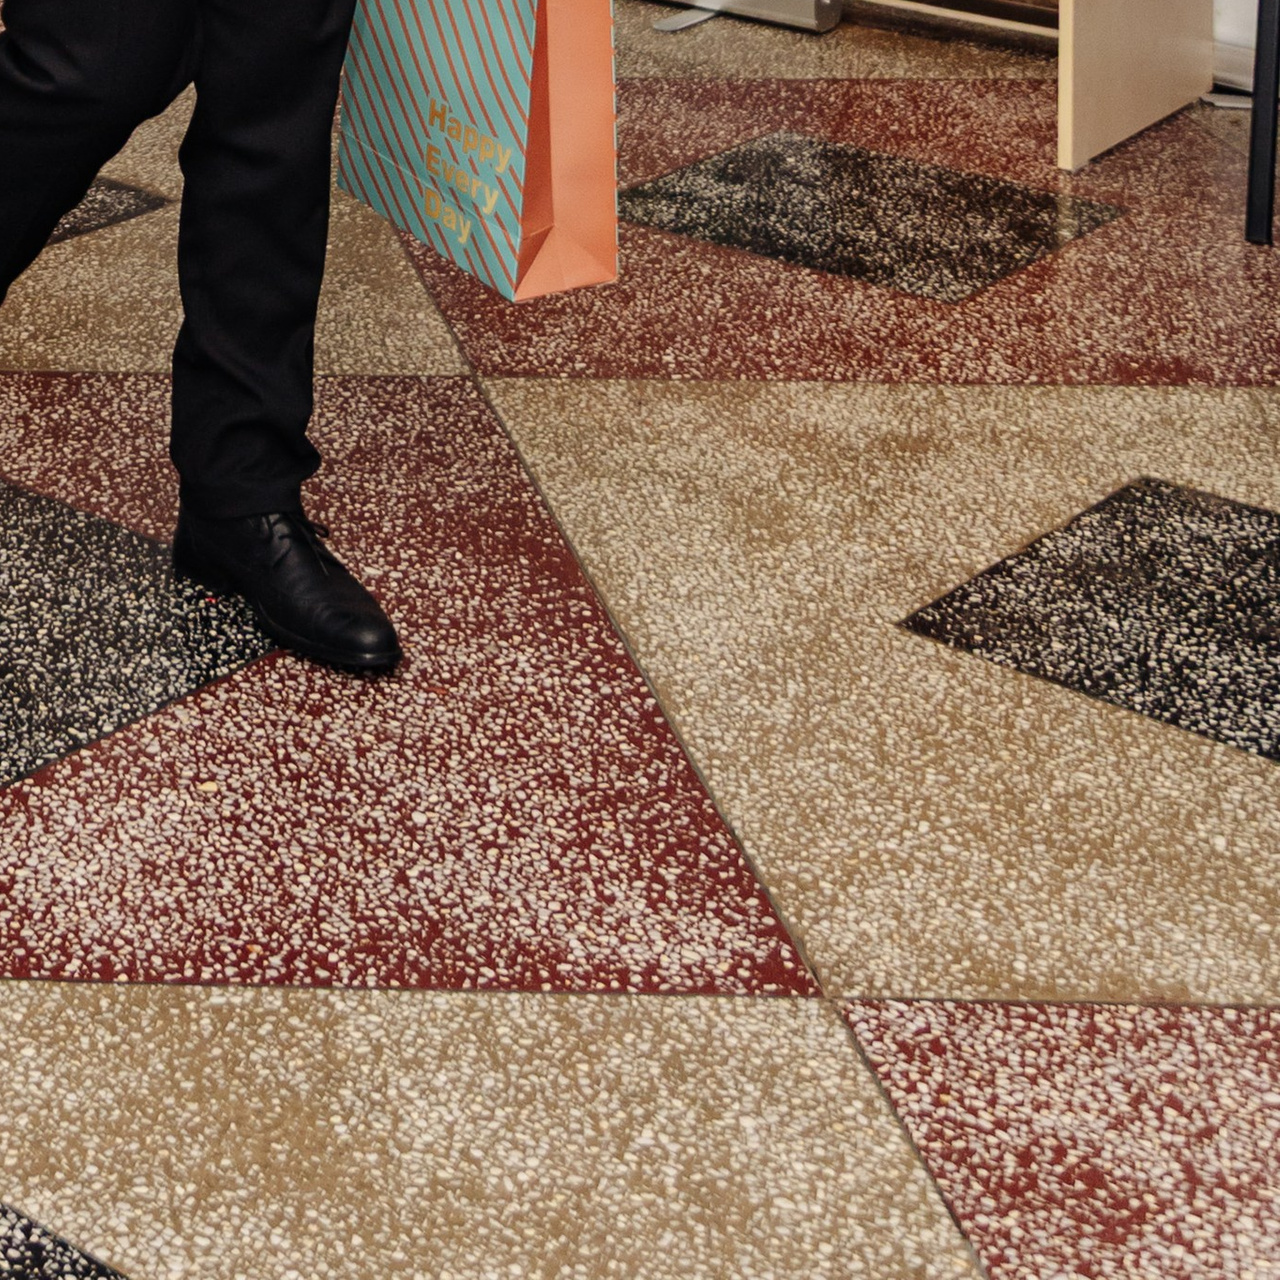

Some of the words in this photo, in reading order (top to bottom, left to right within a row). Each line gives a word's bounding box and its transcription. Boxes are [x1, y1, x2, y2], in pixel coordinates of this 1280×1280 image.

[428, 97, 512, 174] Happy
[426, 142, 499, 215] Every
[424, 188, 471, 244] Day
